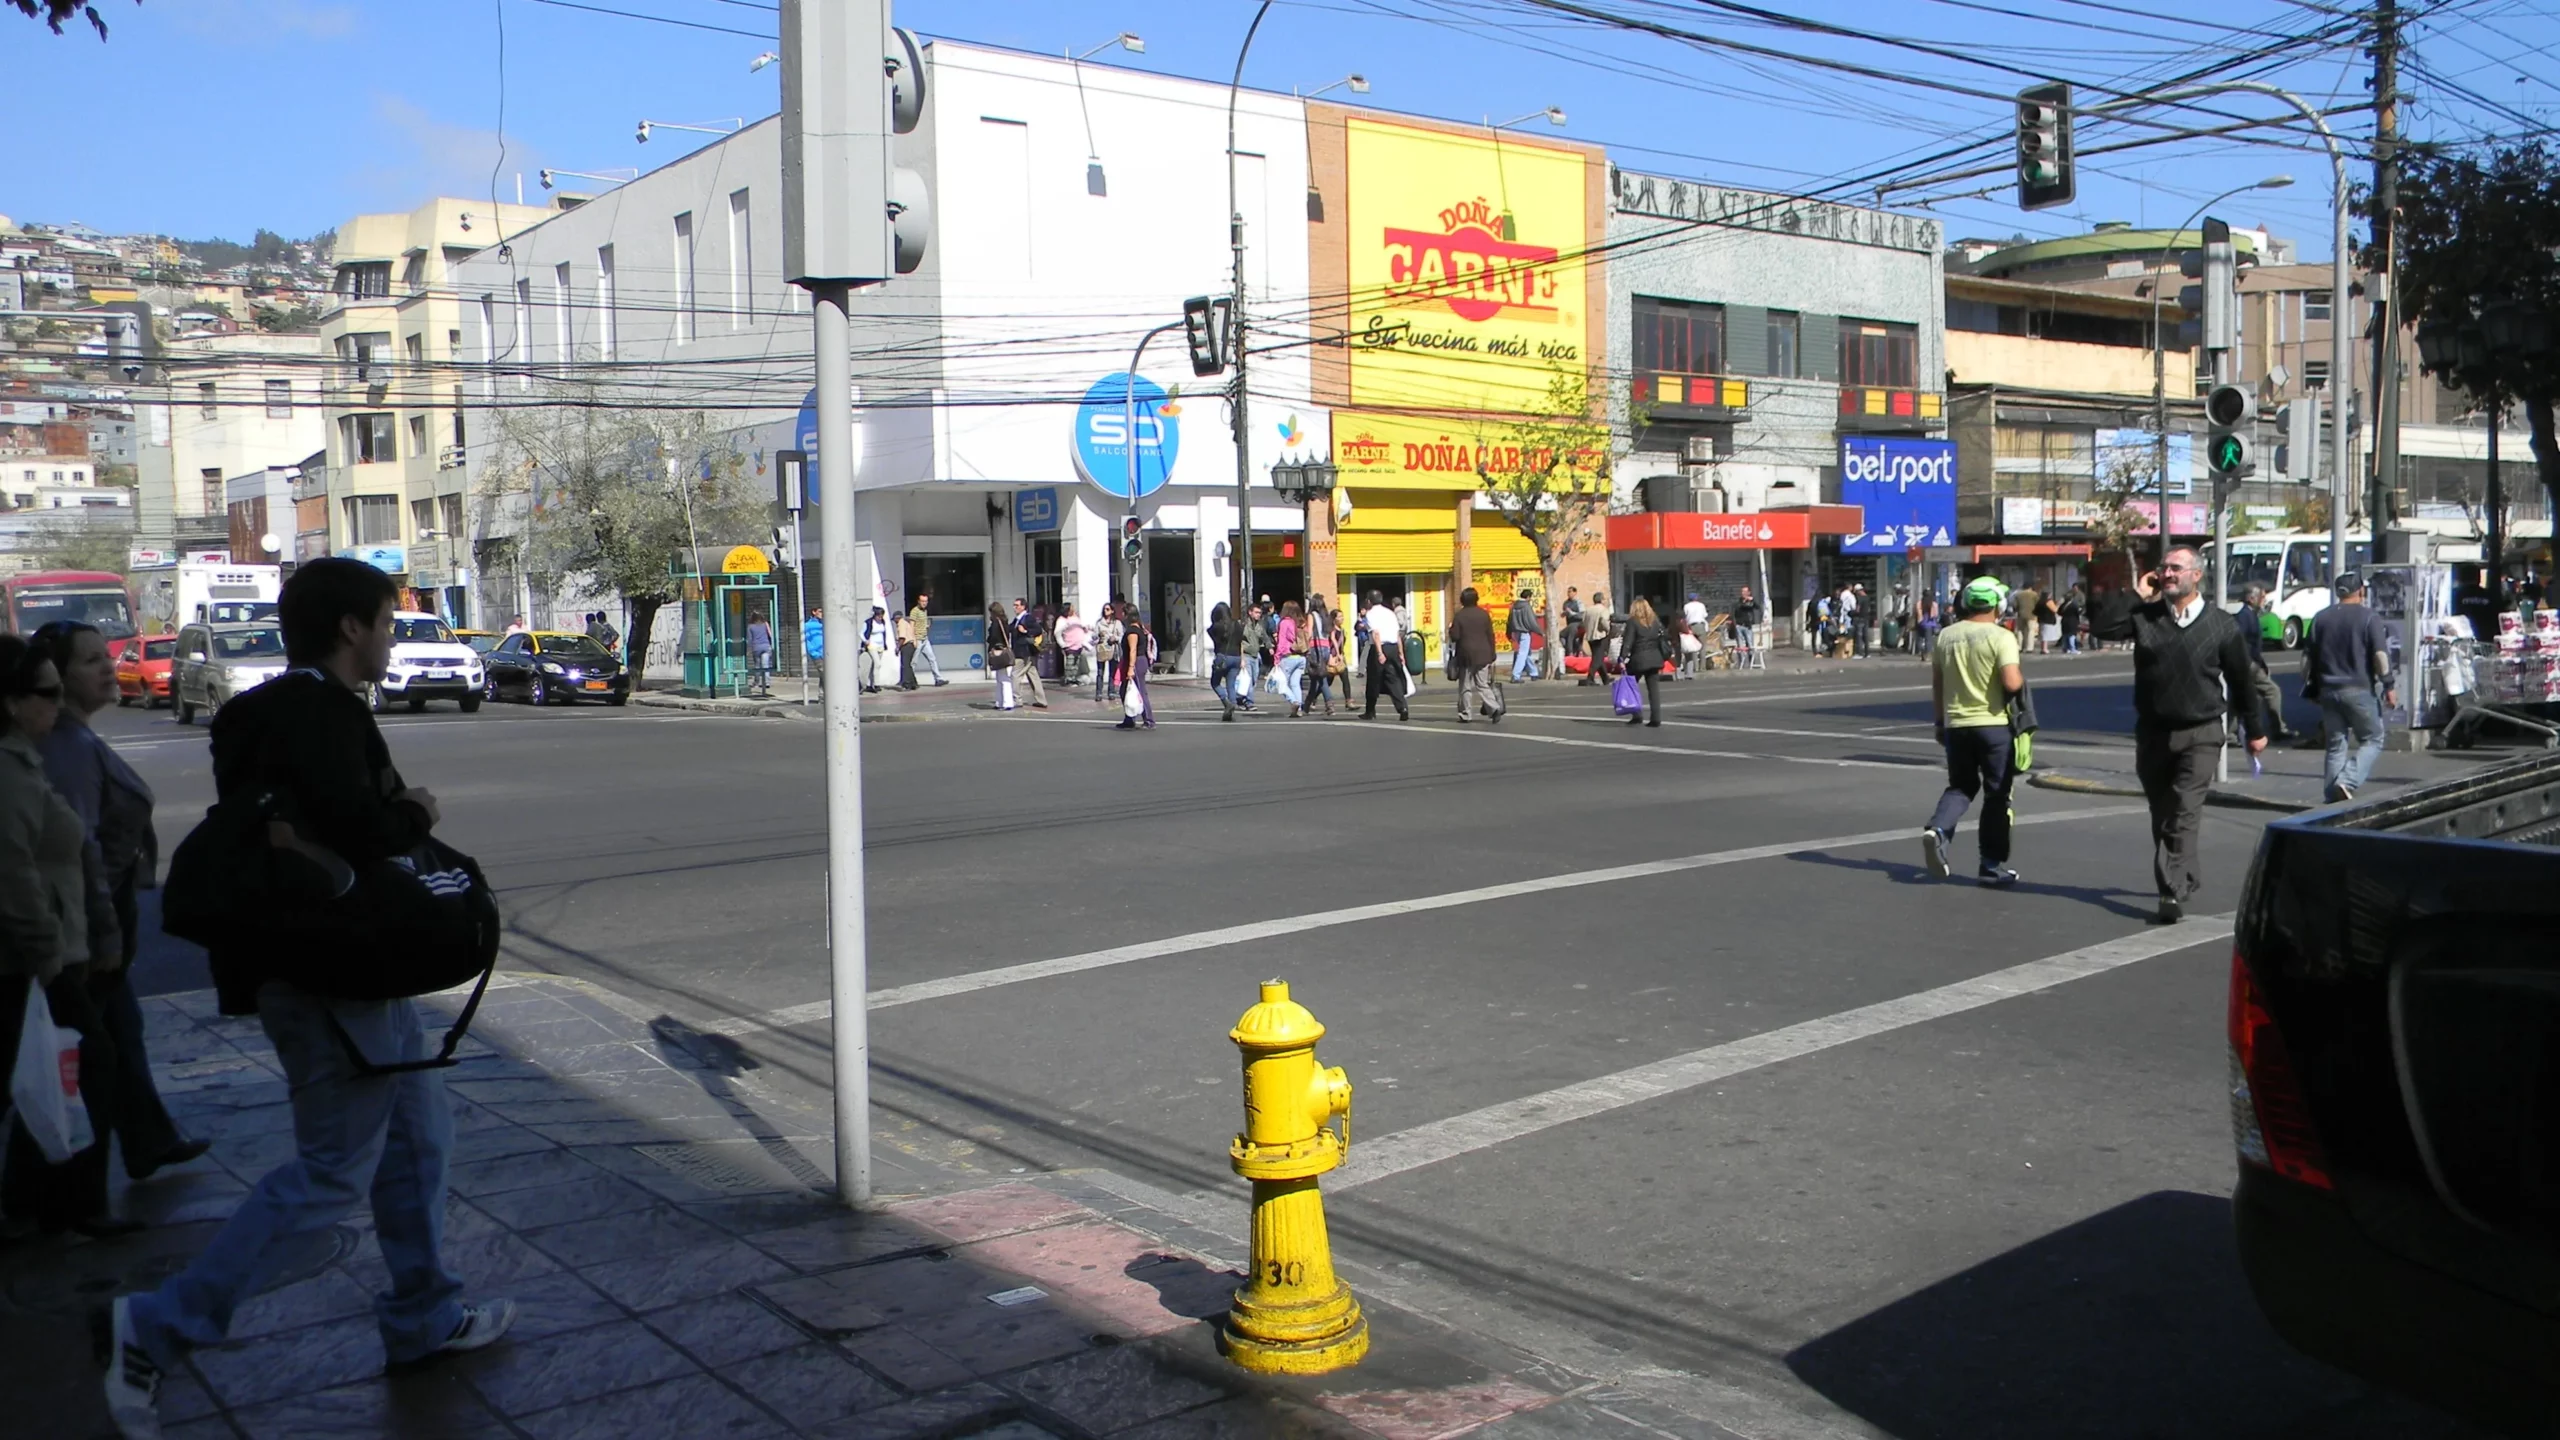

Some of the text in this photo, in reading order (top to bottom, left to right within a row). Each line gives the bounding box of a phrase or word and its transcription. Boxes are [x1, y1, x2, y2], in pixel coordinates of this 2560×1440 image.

[1438, 197, 1504, 238] DOÑA
[1386, 243, 1558, 308] CARNE
[1409, 329, 1478, 352] vecina
[1488, 333, 1529, 359] más
[1538, 337, 1577, 360] rica
[1342, 445, 1389, 461] CARNE
[1404, 435, 1472, 472] DOÑA
[1845, 442, 1952, 494] belsport
[1703, 519, 1753, 540] Banefe
[1516, 588, 1544, 597] GRA-
